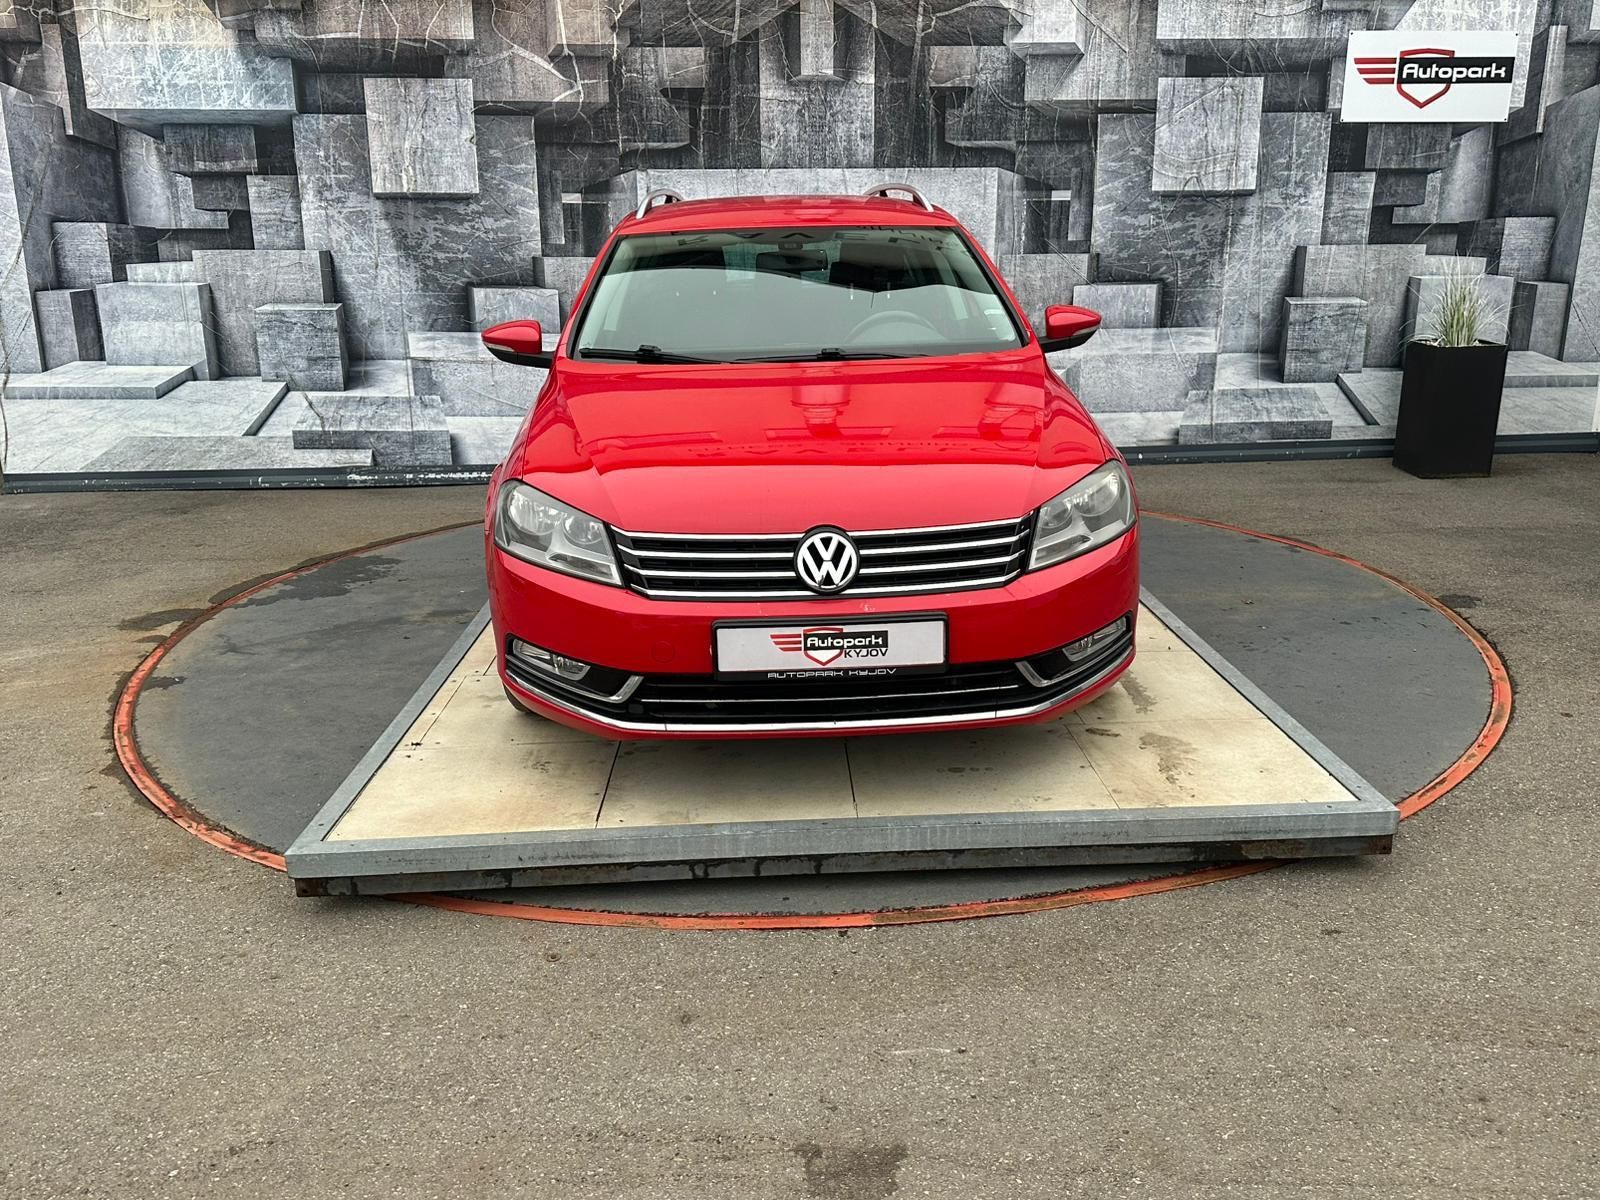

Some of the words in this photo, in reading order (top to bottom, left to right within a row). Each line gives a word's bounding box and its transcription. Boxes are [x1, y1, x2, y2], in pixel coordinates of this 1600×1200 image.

[1402, 63, 1506, 82] Autopark
[807, 635, 883, 649] Autopark
[844, 648, 888, 658] KYJOV
[768, 670, 844, 679] AUTOPARK
[848, 668, 897, 676] KYJOV
